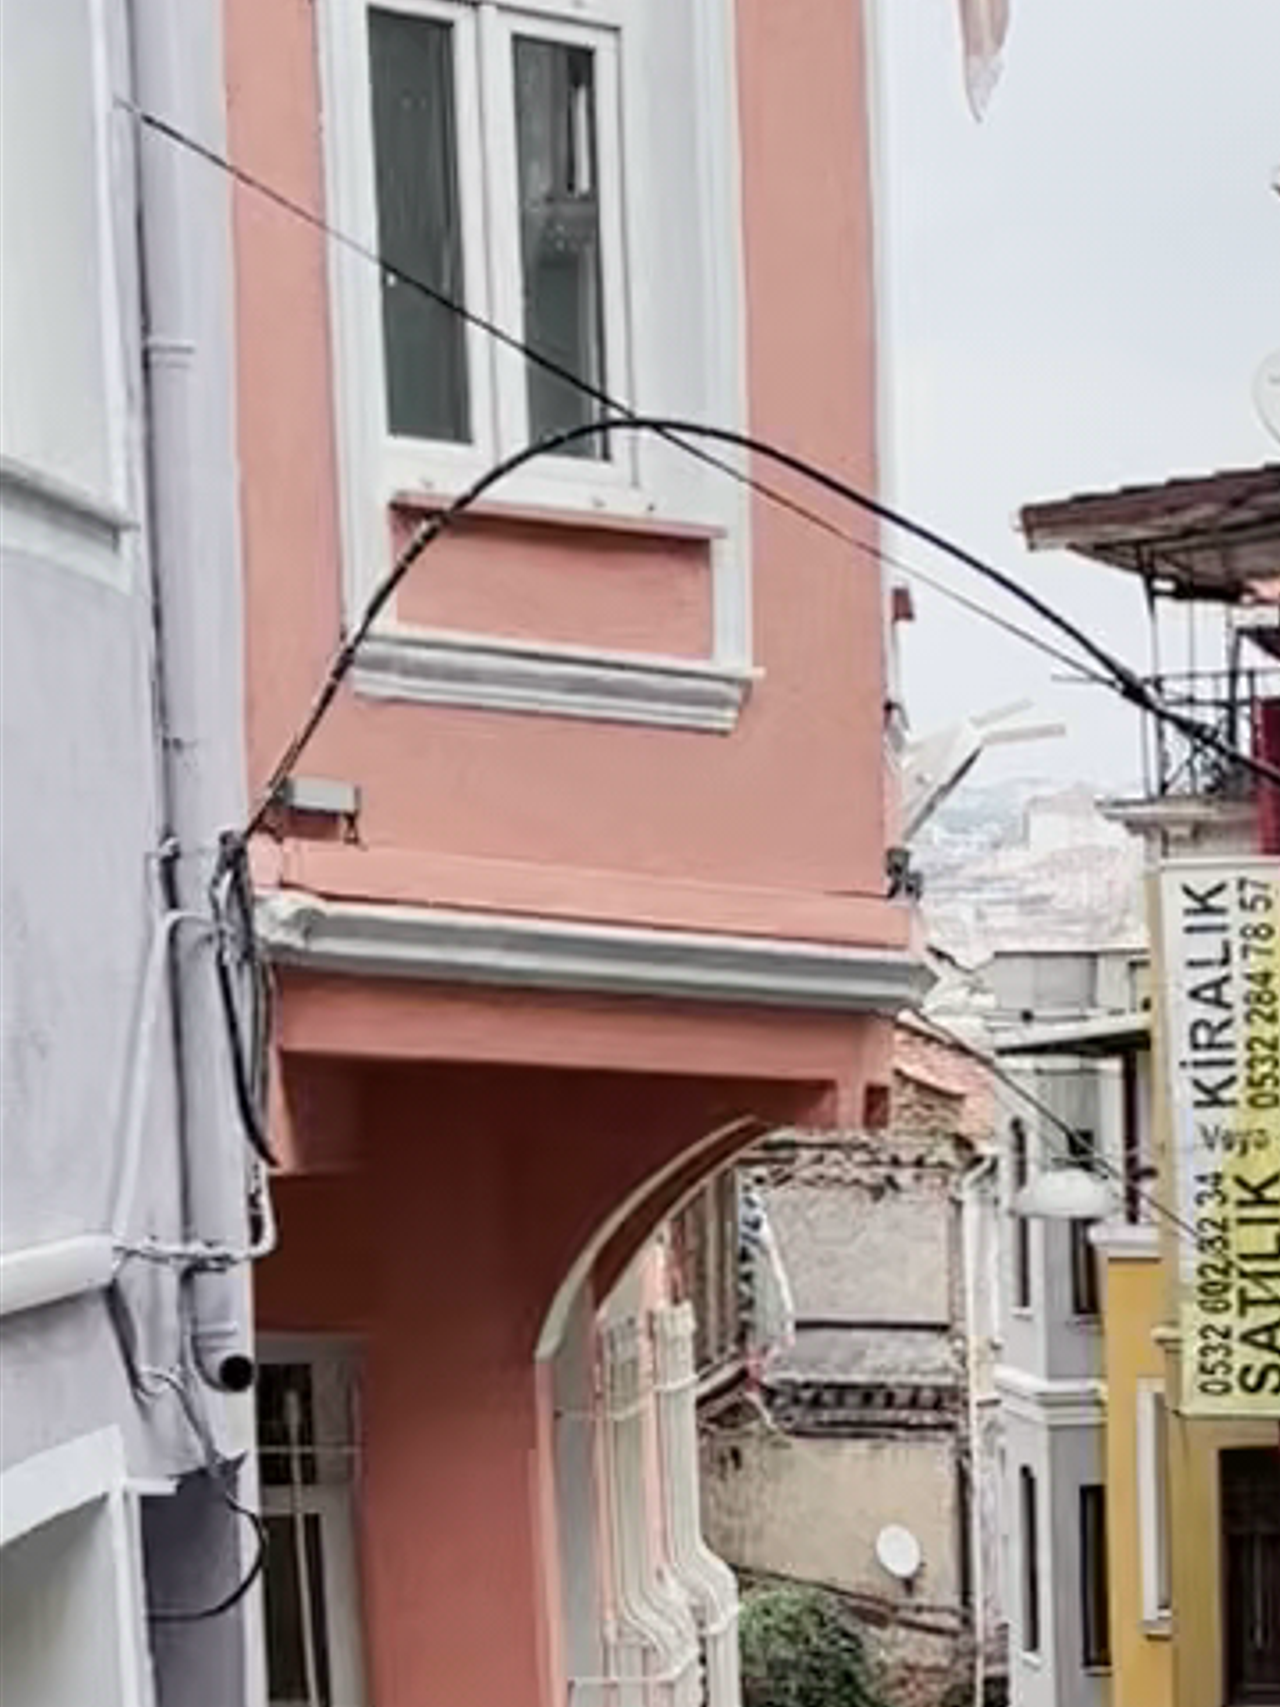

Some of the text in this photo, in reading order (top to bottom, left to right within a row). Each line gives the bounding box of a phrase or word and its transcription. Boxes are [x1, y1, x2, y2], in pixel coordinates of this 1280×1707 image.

[1240, 923, 1276, 959] 78
[1179, 881, 1238, 1109] KİRALIK
[1243, 970, 1279, 1023] 284
[1247, 1036, 1280, 1109] 0532
[1198, 1324, 1233, 1396] 0532
